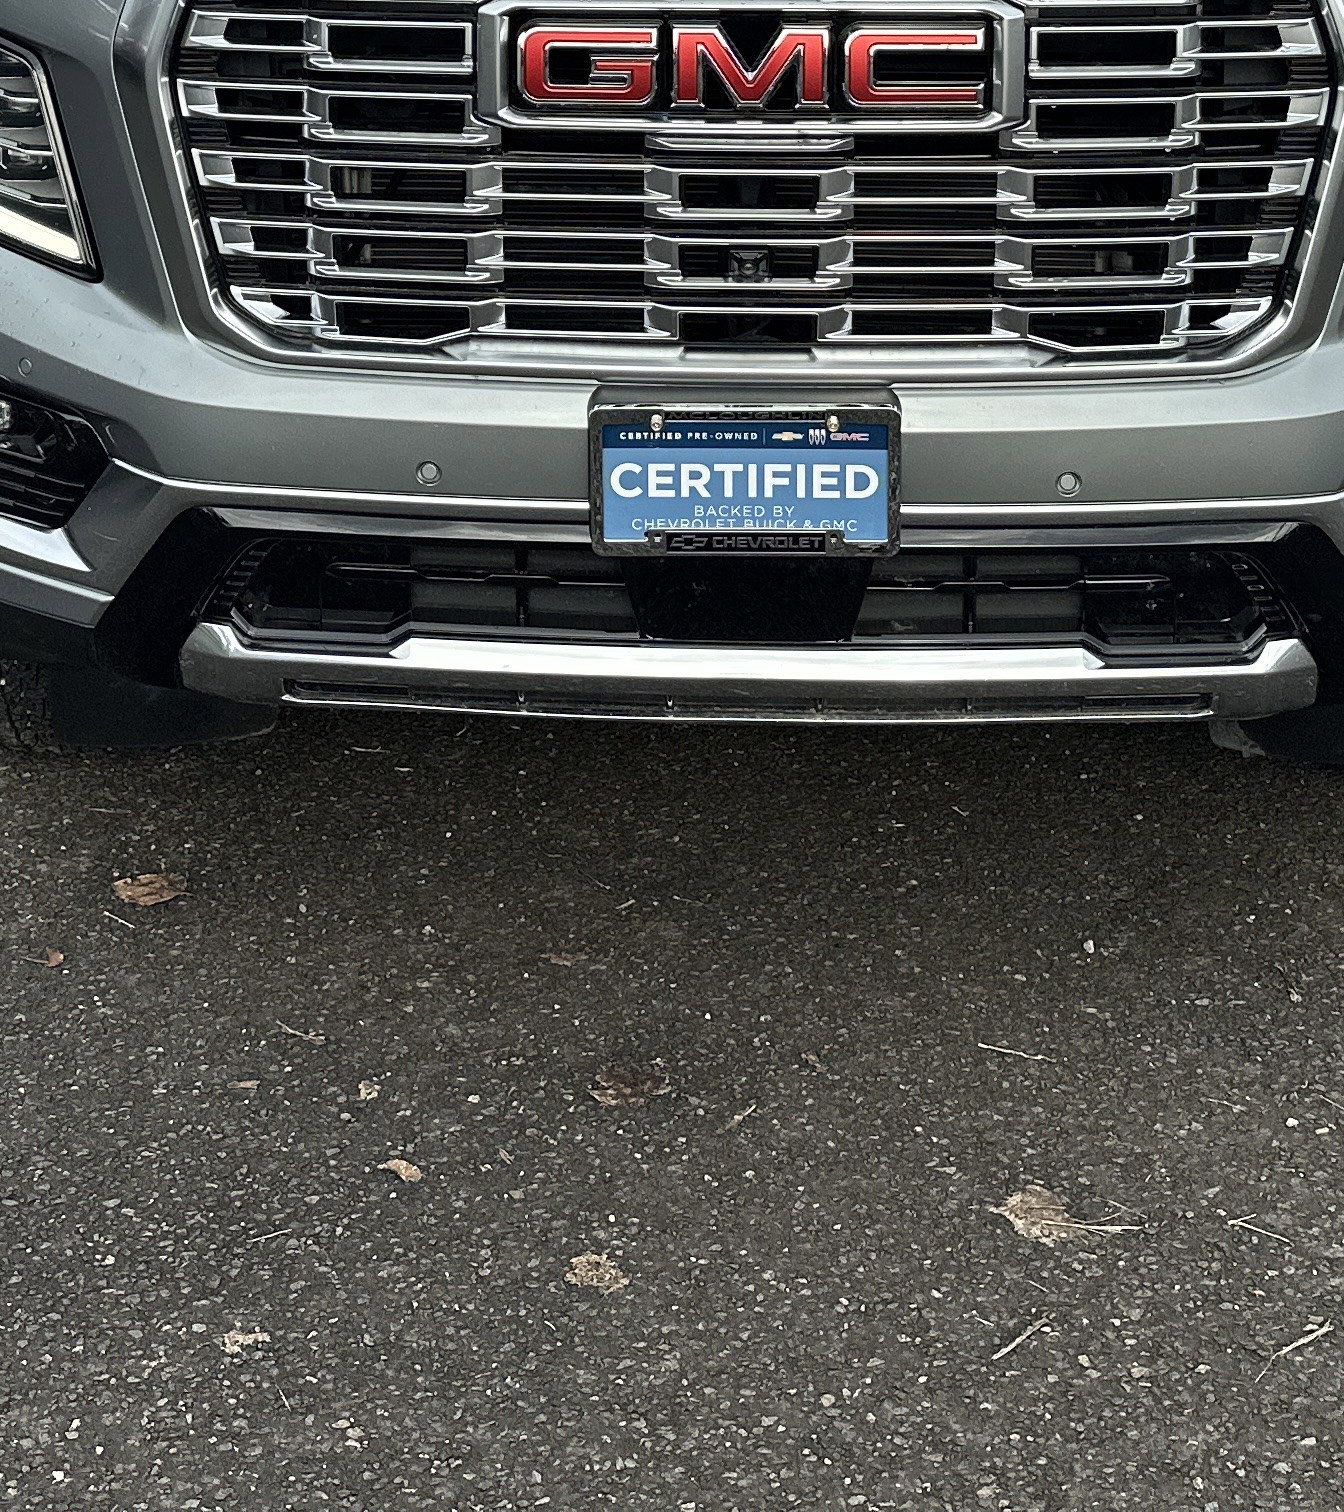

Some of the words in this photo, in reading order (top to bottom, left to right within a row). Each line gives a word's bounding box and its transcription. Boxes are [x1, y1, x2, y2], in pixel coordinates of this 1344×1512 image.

[516, 19, 987, 110] GMC
[619, 431, 682, 440] CERTIFIED
[687, 431, 758, 440] PRE-OWNED
[829, 432, 870, 442] GMC
[609, 462, 880, 499] CERTIFIED
[693, 505, 766, 517] BACKED
[773, 505, 795, 517] BY
[802, 519, 814, 529] &
[819, 519, 858, 532] GMC
[712, 536, 824, 549] CHEVROLET
